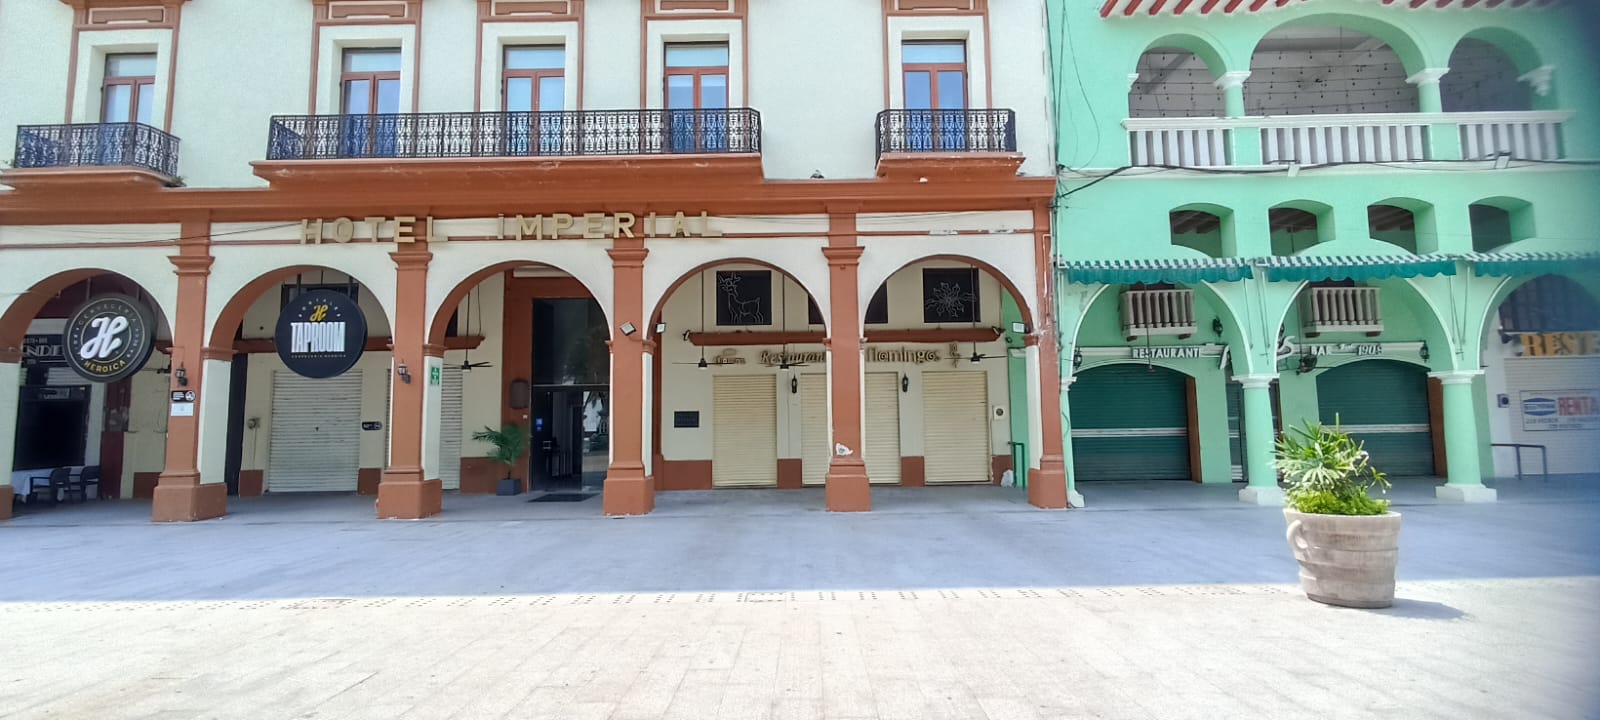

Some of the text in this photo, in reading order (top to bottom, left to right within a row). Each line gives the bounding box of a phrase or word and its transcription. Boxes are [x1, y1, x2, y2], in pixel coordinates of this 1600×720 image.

[300, 210, 722, 244] HOTEL IMPERIAL
[290, 321, 346, 353] TAPROOM
[1311, 345, 1333, 356] BAR
[83, 359, 126, 373] HEROICA
